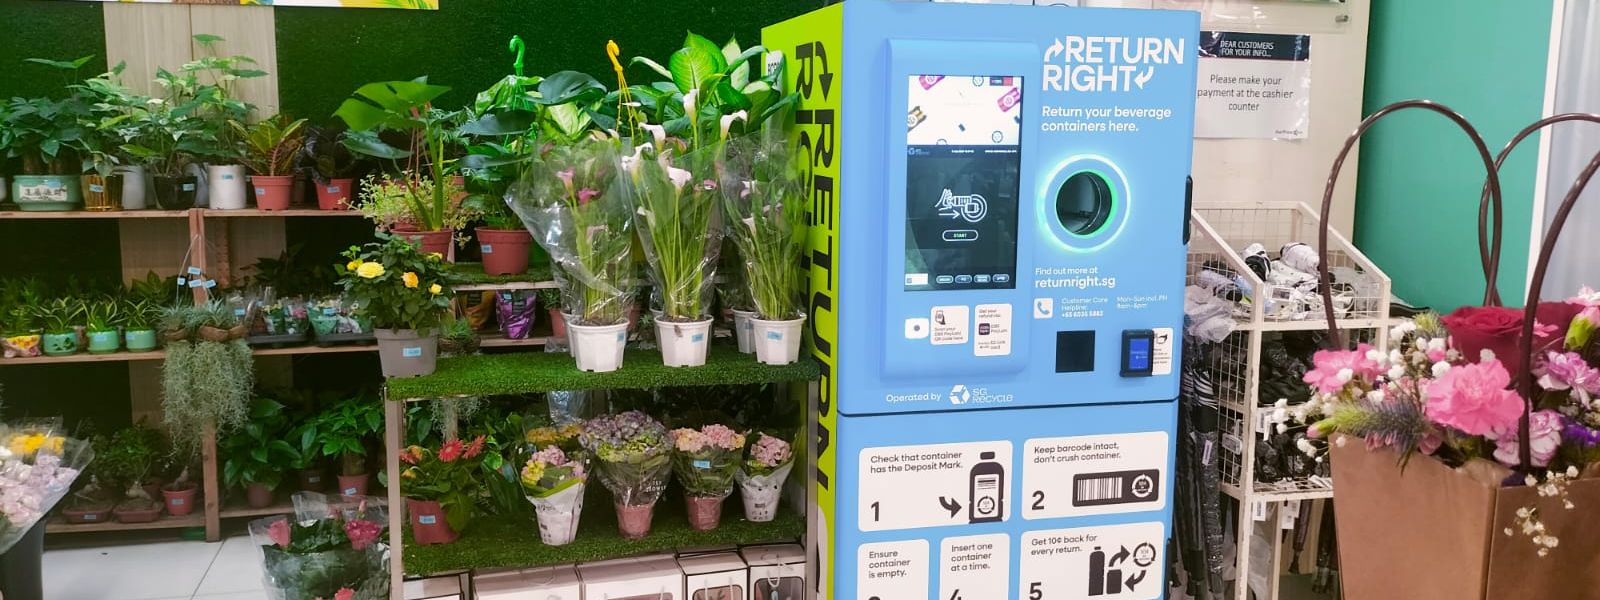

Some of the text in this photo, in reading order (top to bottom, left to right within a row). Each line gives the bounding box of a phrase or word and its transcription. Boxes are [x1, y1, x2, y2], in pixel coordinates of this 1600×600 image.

[1065, 36, 1185, 64] RETURN
[1220, 40, 1274, 50] DEAR CUSTOMERS
[1221, 48, 1234, 56] FOR
[1043, 65, 1137, 92] RIGHT
[1210, 74, 1283, 87] Please make your
[1197, 89, 1294, 99] payment at the cashier
[1228, 102, 1260, 111] counter
[1042, 106, 1172, 120] Return your beverage
[1041, 121, 1139, 132] containers here.
[1035, 267, 1052, 275] Find
[1089, 266, 1098, 274] at
[1035, 276, 1116, 289] returnright.sg
[886, 392, 942, 403] Operated by
[1034, 442, 1119, 455] Keep barcode intact,
[870, 451, 963, 463] Check that container
[1034, 451, 1121, 464] don't crush container.
[870, 461, 963, 474] has the Deposit Mark.
[1031, 490, 1045, 510] 2
[870, 501, 880, 522] 1
[1031, 534, 1098, 546] Get 10¢ back for
[951, 544, 976, 552] Insert
[1030, 544, 1082, 556] every return.
[868, 550, 898, 559] Ensure
[951, 552, 992, 562] container
[868, 559, 911, 569] container
[951, 563, 961, 572] at
[969, 562, 990, 571] time.
[868, 569, 907, 580] is empty.
[1029, 582, 1043, 600] 5
